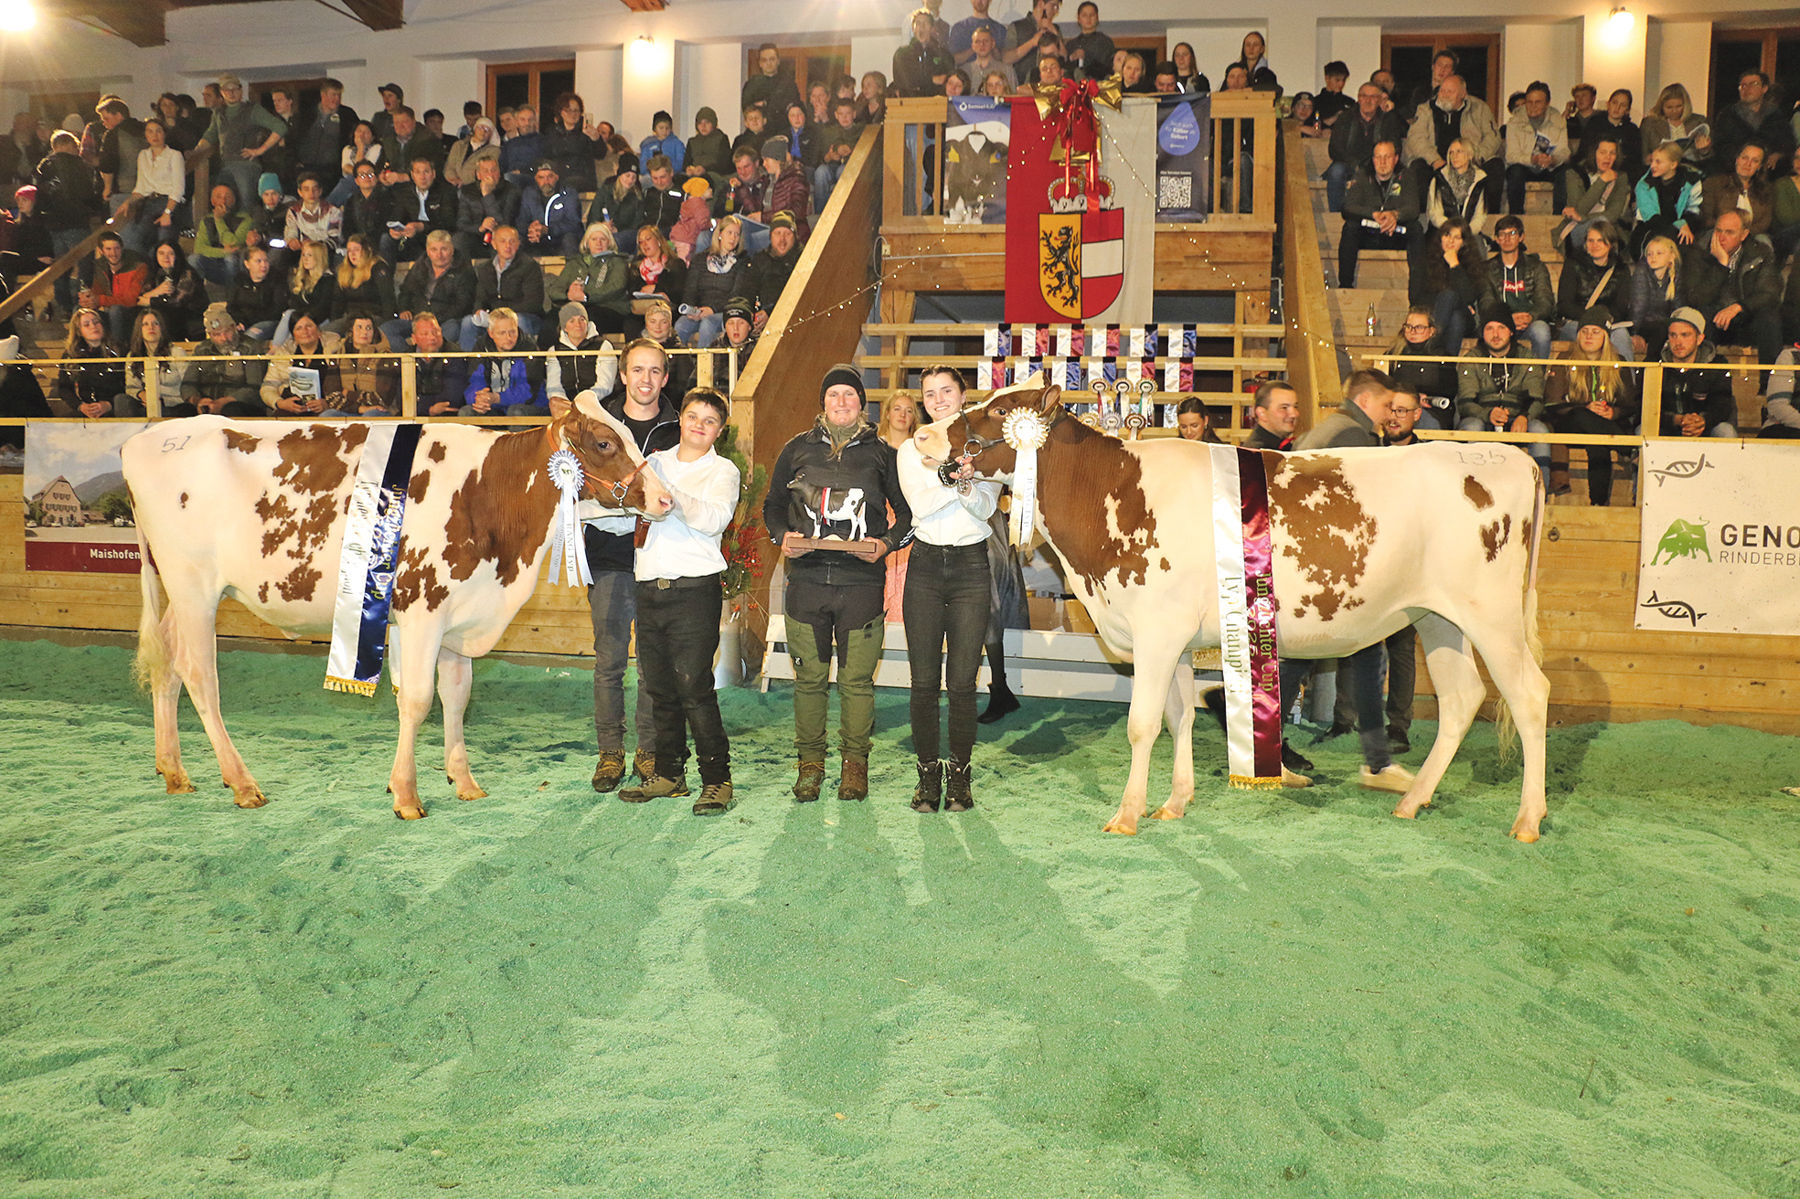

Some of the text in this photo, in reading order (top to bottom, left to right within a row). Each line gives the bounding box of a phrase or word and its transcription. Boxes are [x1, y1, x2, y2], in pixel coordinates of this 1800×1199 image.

[161, 435, 191, 453] 51
[1720, 523, 1800, 548] GENO
[89, 547, 141, 560] Maishofen
[1719, 550, 1800, 566] RINDERB
[1259, 662, 1277, 692] Cup
